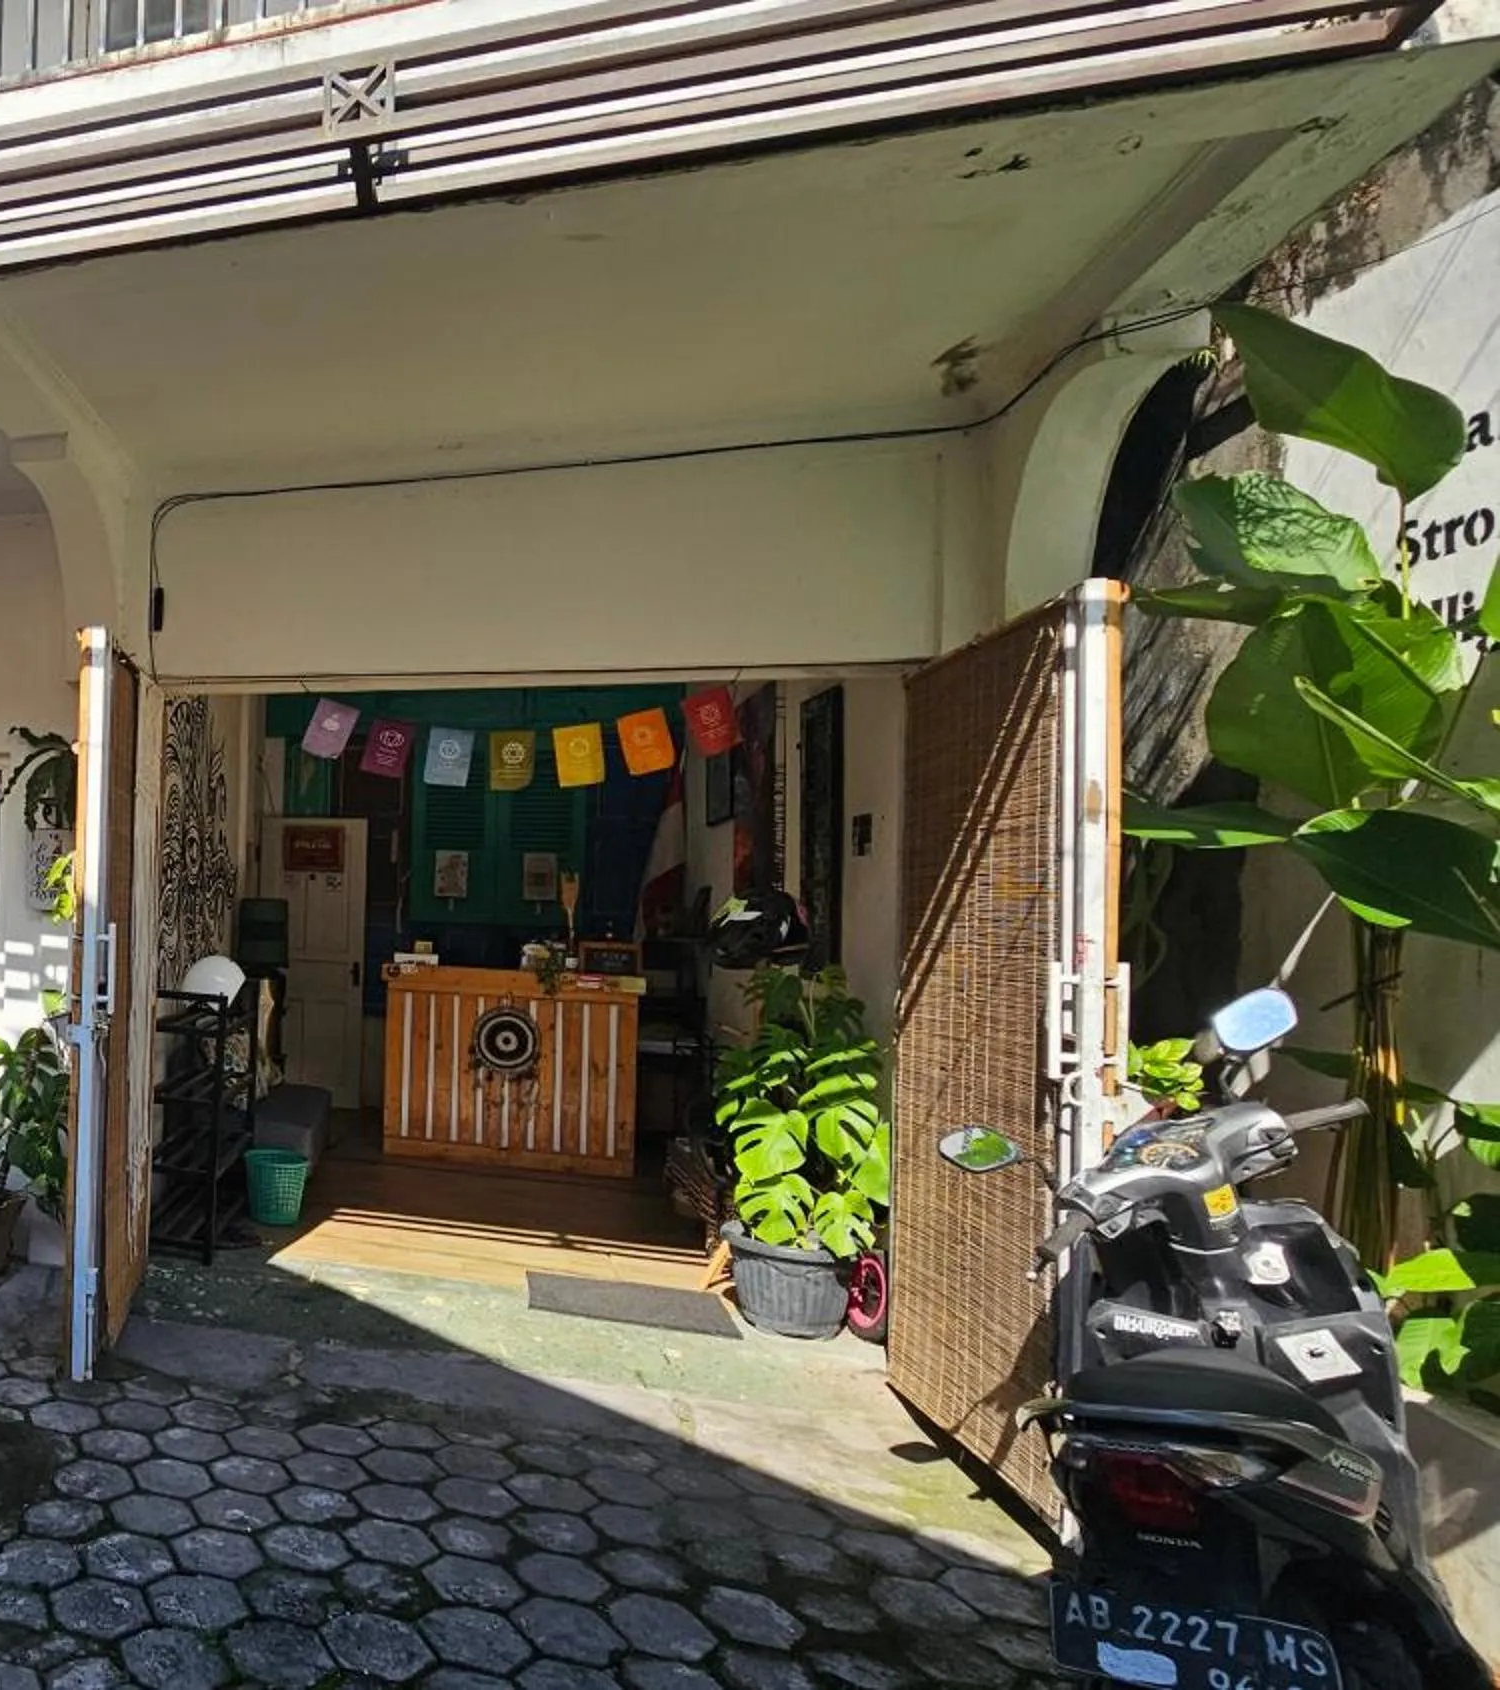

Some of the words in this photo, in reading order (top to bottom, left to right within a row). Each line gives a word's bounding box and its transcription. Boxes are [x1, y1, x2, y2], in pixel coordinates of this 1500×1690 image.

[1064, 1591, 1113, 1631] AB
[1130, 1604, 1240, 1657] 2227
[1263, 1629, 1329, 1677] MS
